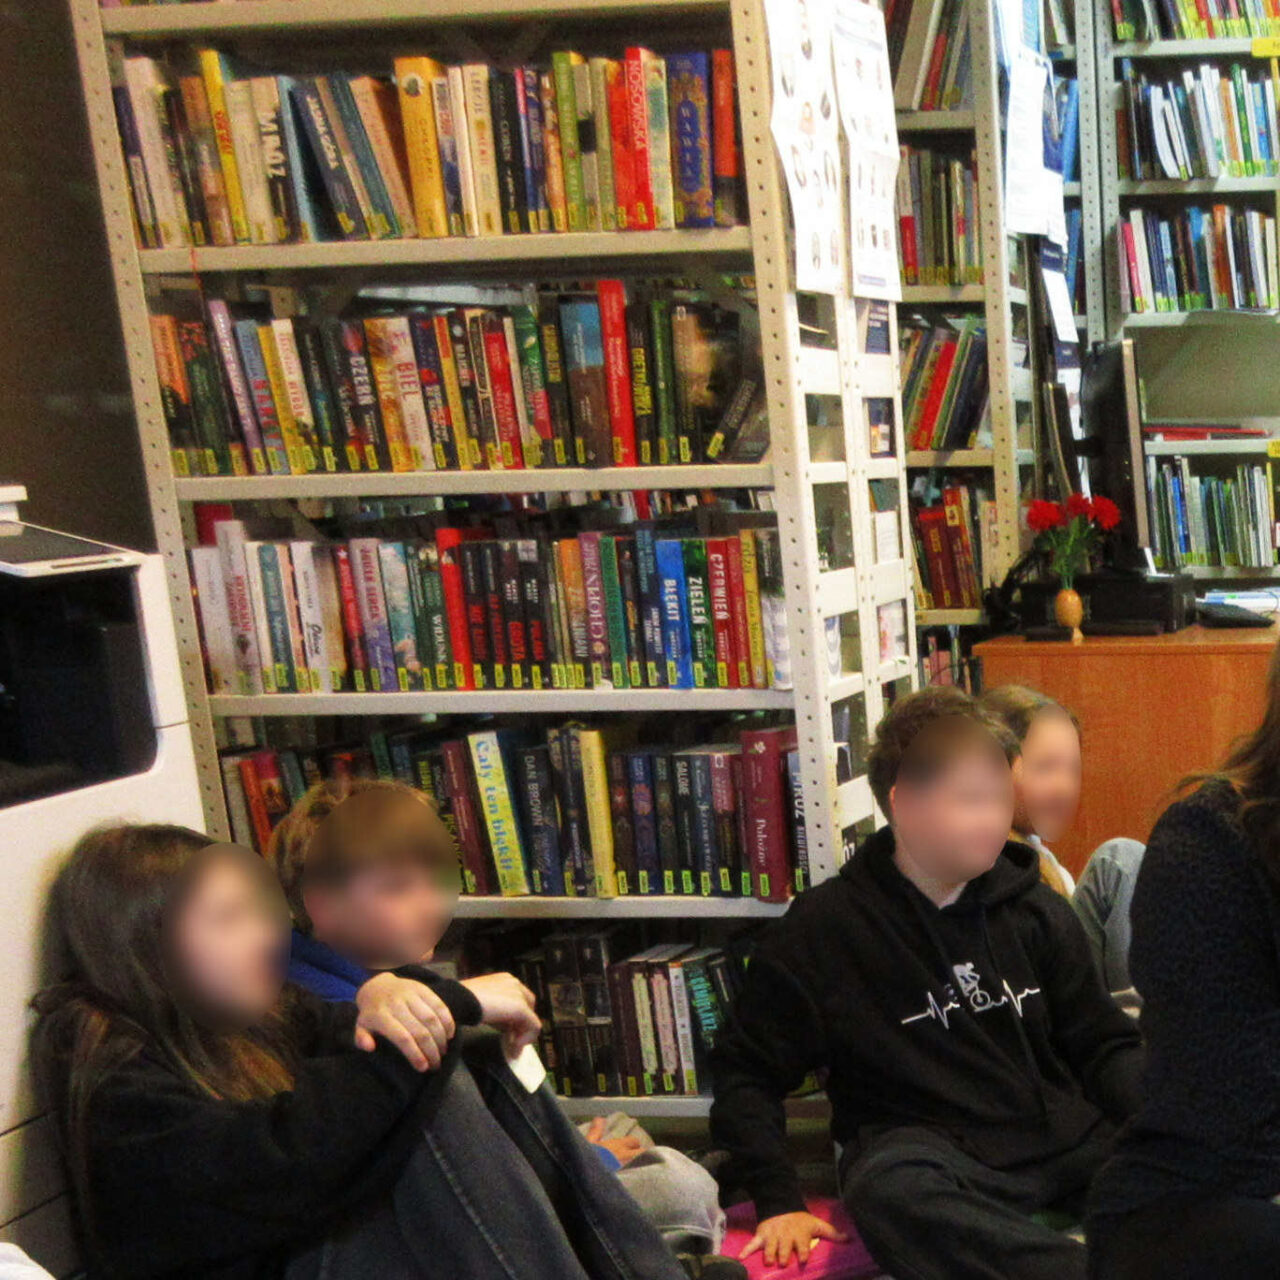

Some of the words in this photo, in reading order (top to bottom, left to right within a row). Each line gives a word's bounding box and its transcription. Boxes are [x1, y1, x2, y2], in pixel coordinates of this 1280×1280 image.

[629, 60, 646, 150] NOSOWSKA
[260, 110, 287, 180] MRÓZ
[350, 356, 376, 406] CZERŃ
[396, 362, 420, 401] BIEL
[664, 579, 679, 621] BŁĘKIT
[689, 577, 709, 624] ZIELEŃ
[710, 554, 730, 620] CZERWIEŃ
[524, 755, 536, 779] DAN
[485, 787, 502, 814] ten
[529, 783, 543, 827] BROWN
